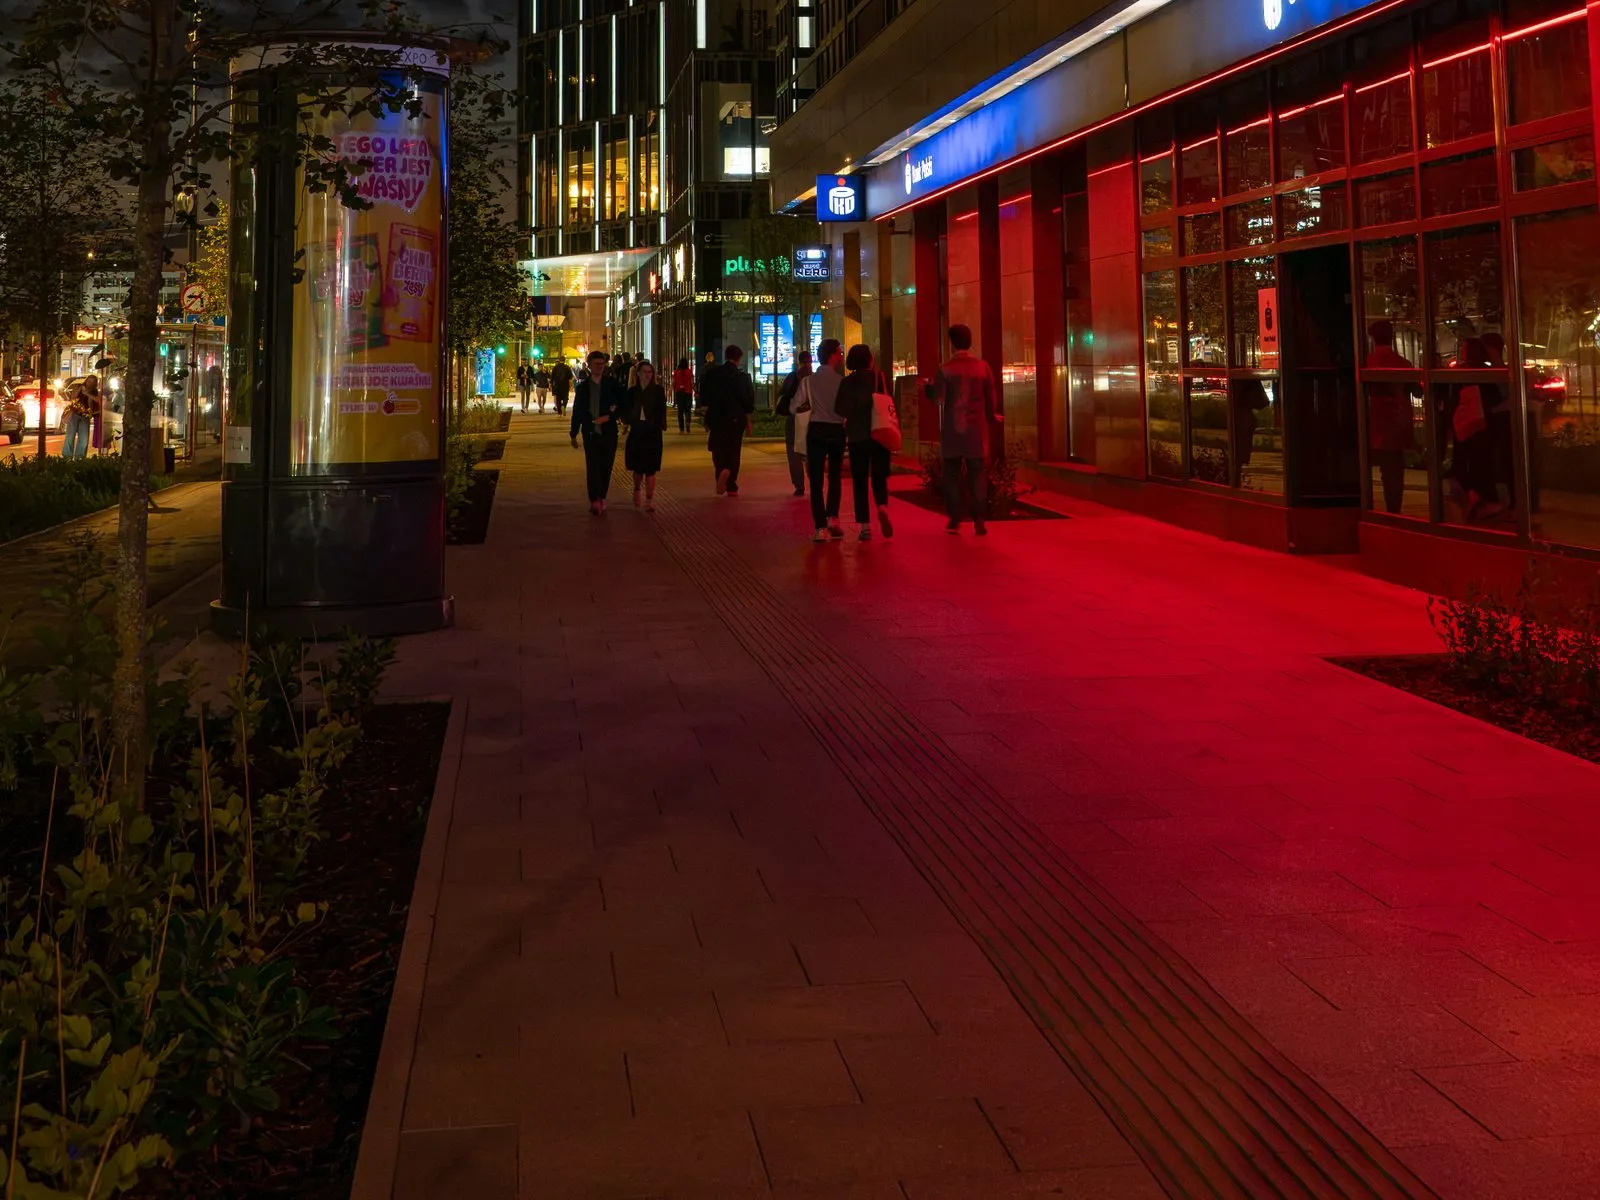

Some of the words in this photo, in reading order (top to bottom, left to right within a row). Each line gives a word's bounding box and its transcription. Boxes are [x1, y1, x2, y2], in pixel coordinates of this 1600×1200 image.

[333, 136, 386, 154] TEGO
[401, 158, 431, 176] JEST
[350, 174, 424, 209] WAŚNY
[725, 255, 766, 276] plus
[794, 268, 830, 277] NERO
